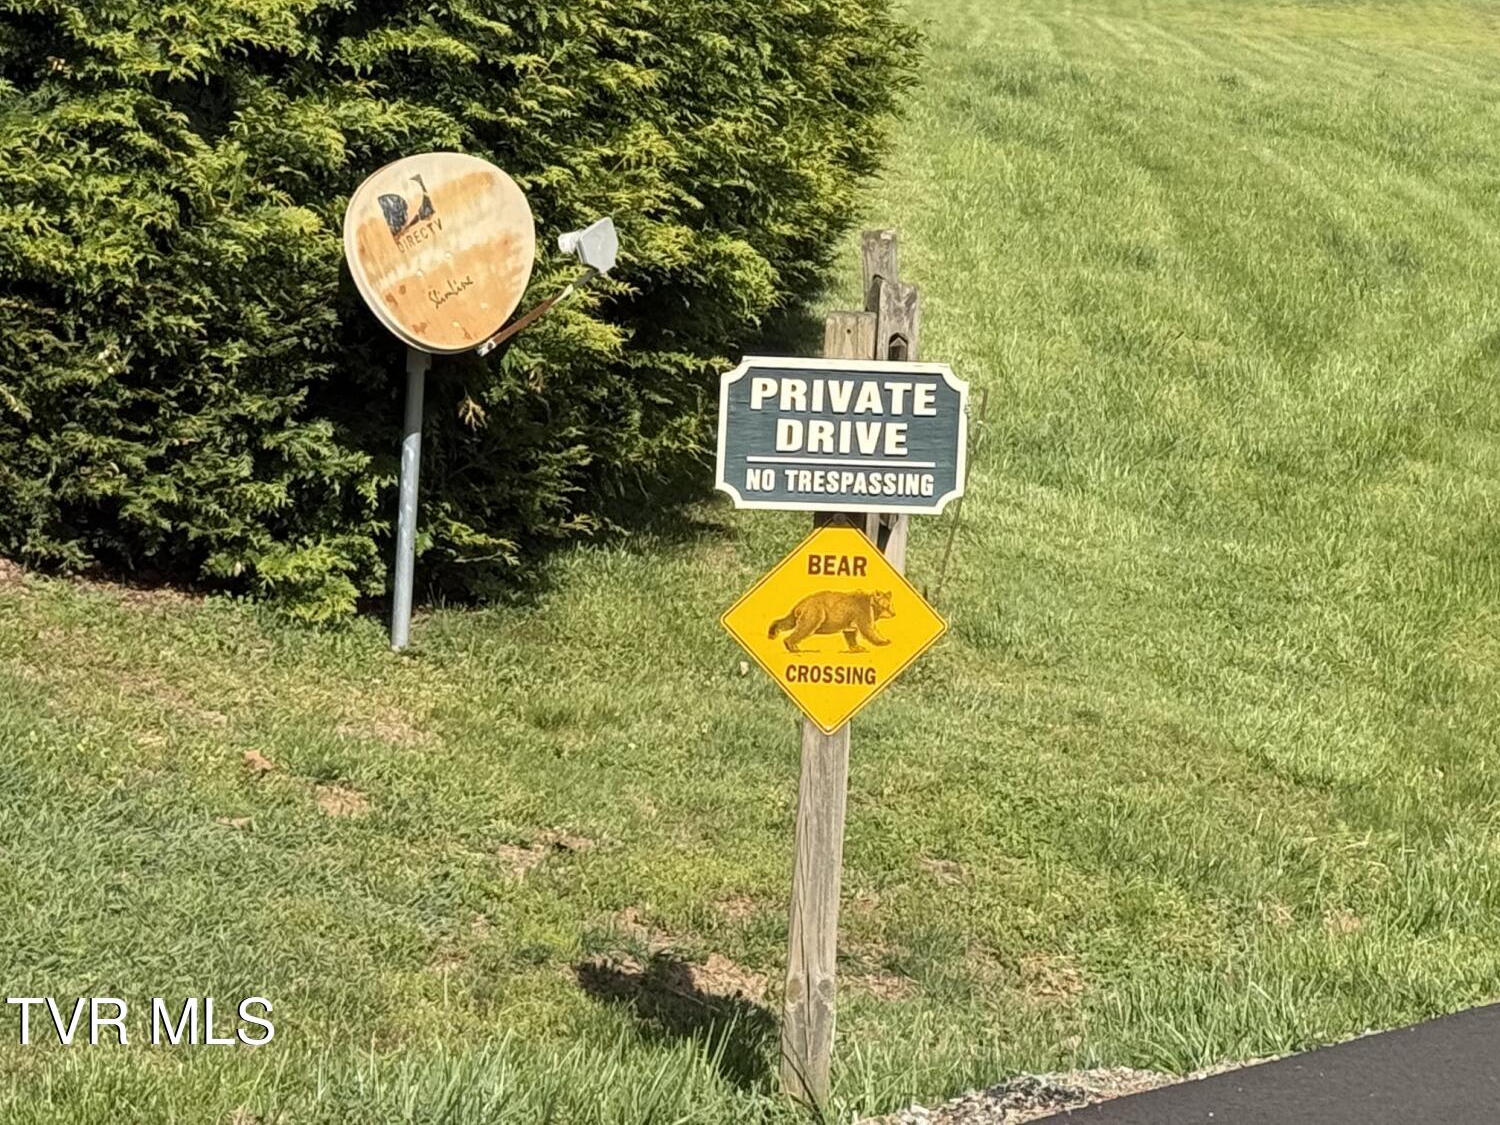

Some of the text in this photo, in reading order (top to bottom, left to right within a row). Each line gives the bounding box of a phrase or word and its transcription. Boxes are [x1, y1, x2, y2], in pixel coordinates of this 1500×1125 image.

[397, 218, 443, 253] DIRECTV
[750, 377, 937, 416] PRIVATE
[775, 418, 909, 456] DRIVE
[745, 468, 935, 498] NO TRESPASSING
[807, 555, 868, 578] BEAR
[785, 664, 877, 686] CROSSING
